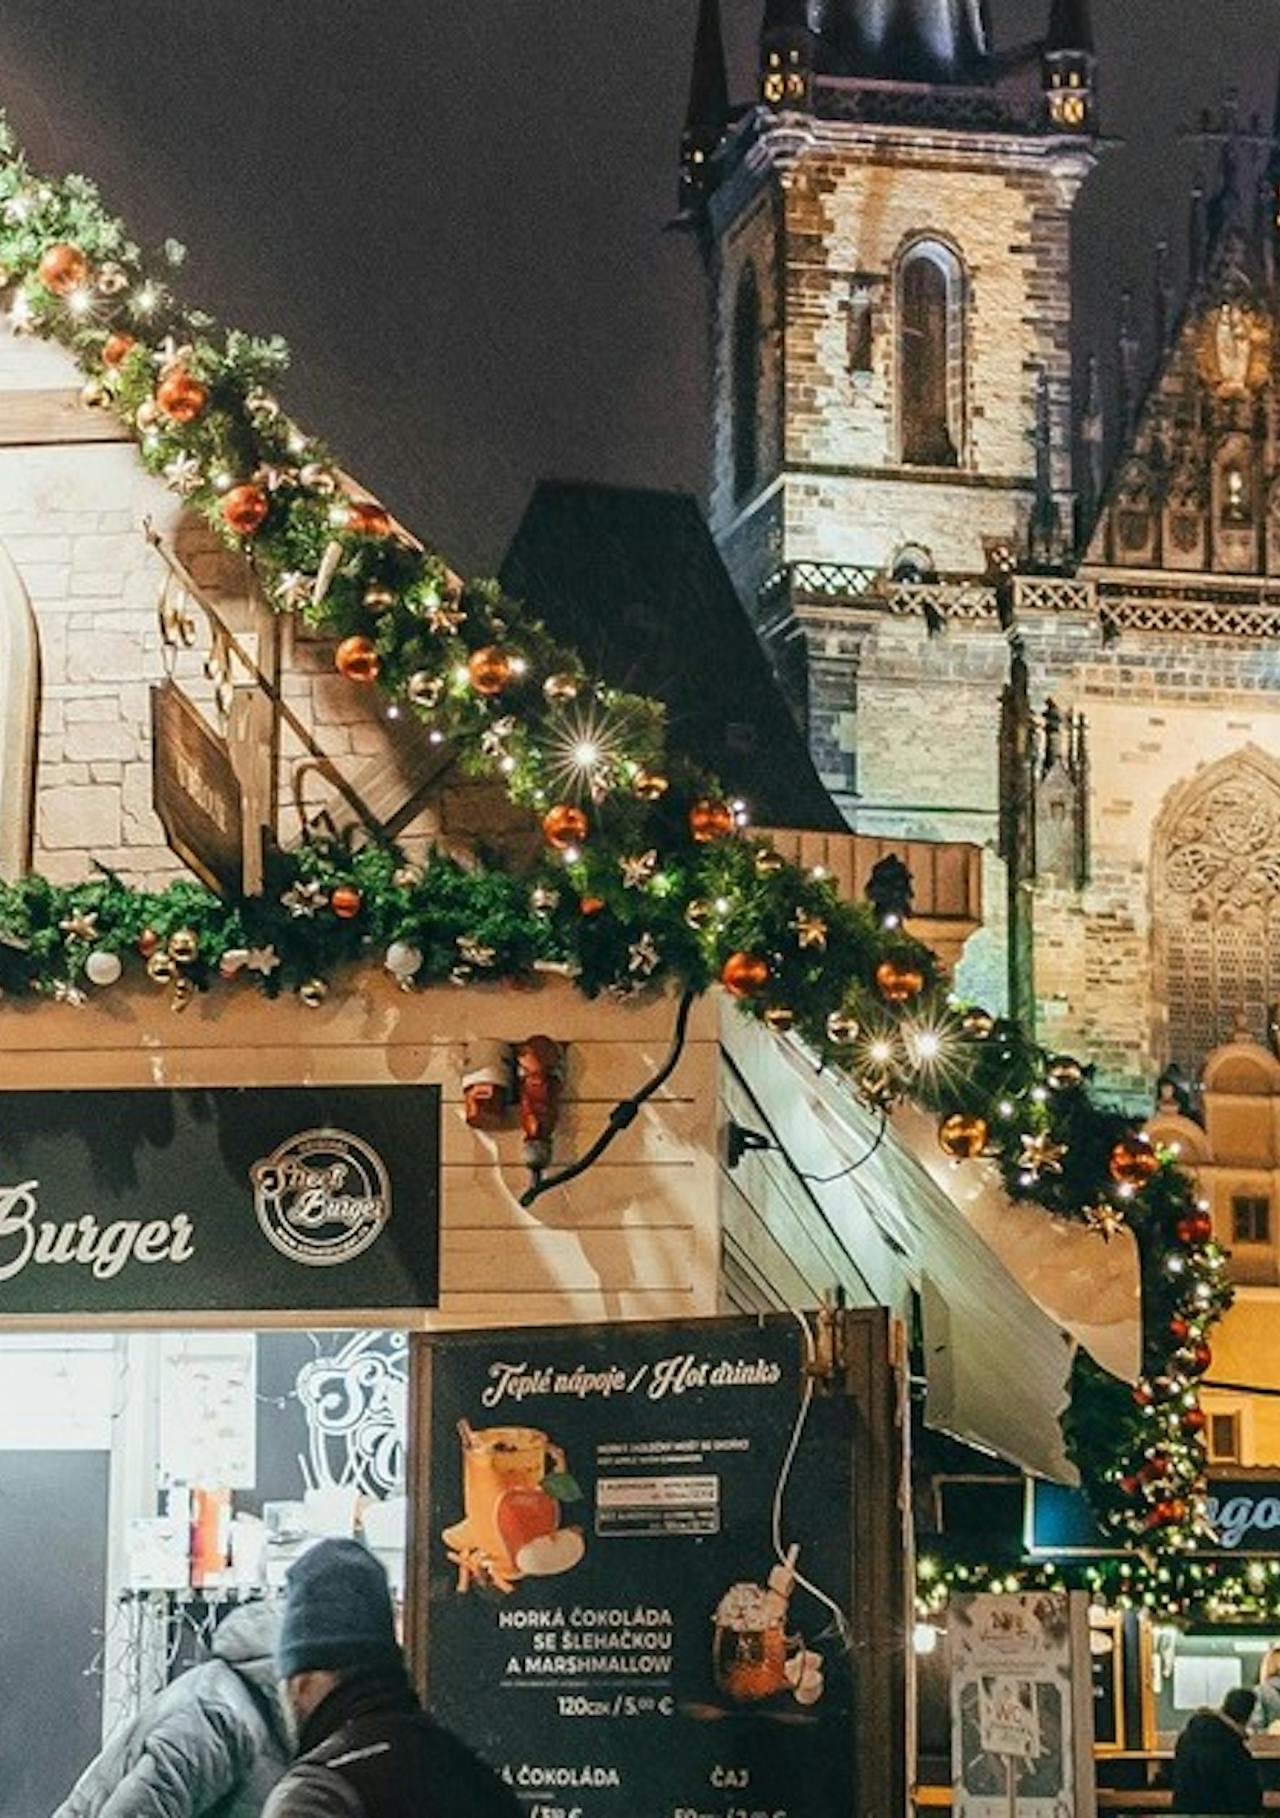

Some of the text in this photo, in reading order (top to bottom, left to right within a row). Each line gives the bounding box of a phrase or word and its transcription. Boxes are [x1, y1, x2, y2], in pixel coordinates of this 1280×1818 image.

[255, 1162, 344, 1199] Street
[481, 1355, 782, 1408] Teplé nápoje / Hot drinks
[499, 1606, 673, 1629] HORKÁ ČOKOLÁDA
[533, 1629, 672, 1651] SE ŠLEHAČKOU
[506, 1655, 671, 1674] A MARSHMALLOW
[517, 1765, 620, 1786] ČOKOLÁDA
[710, 1765, 750, 1788] ČAJ
